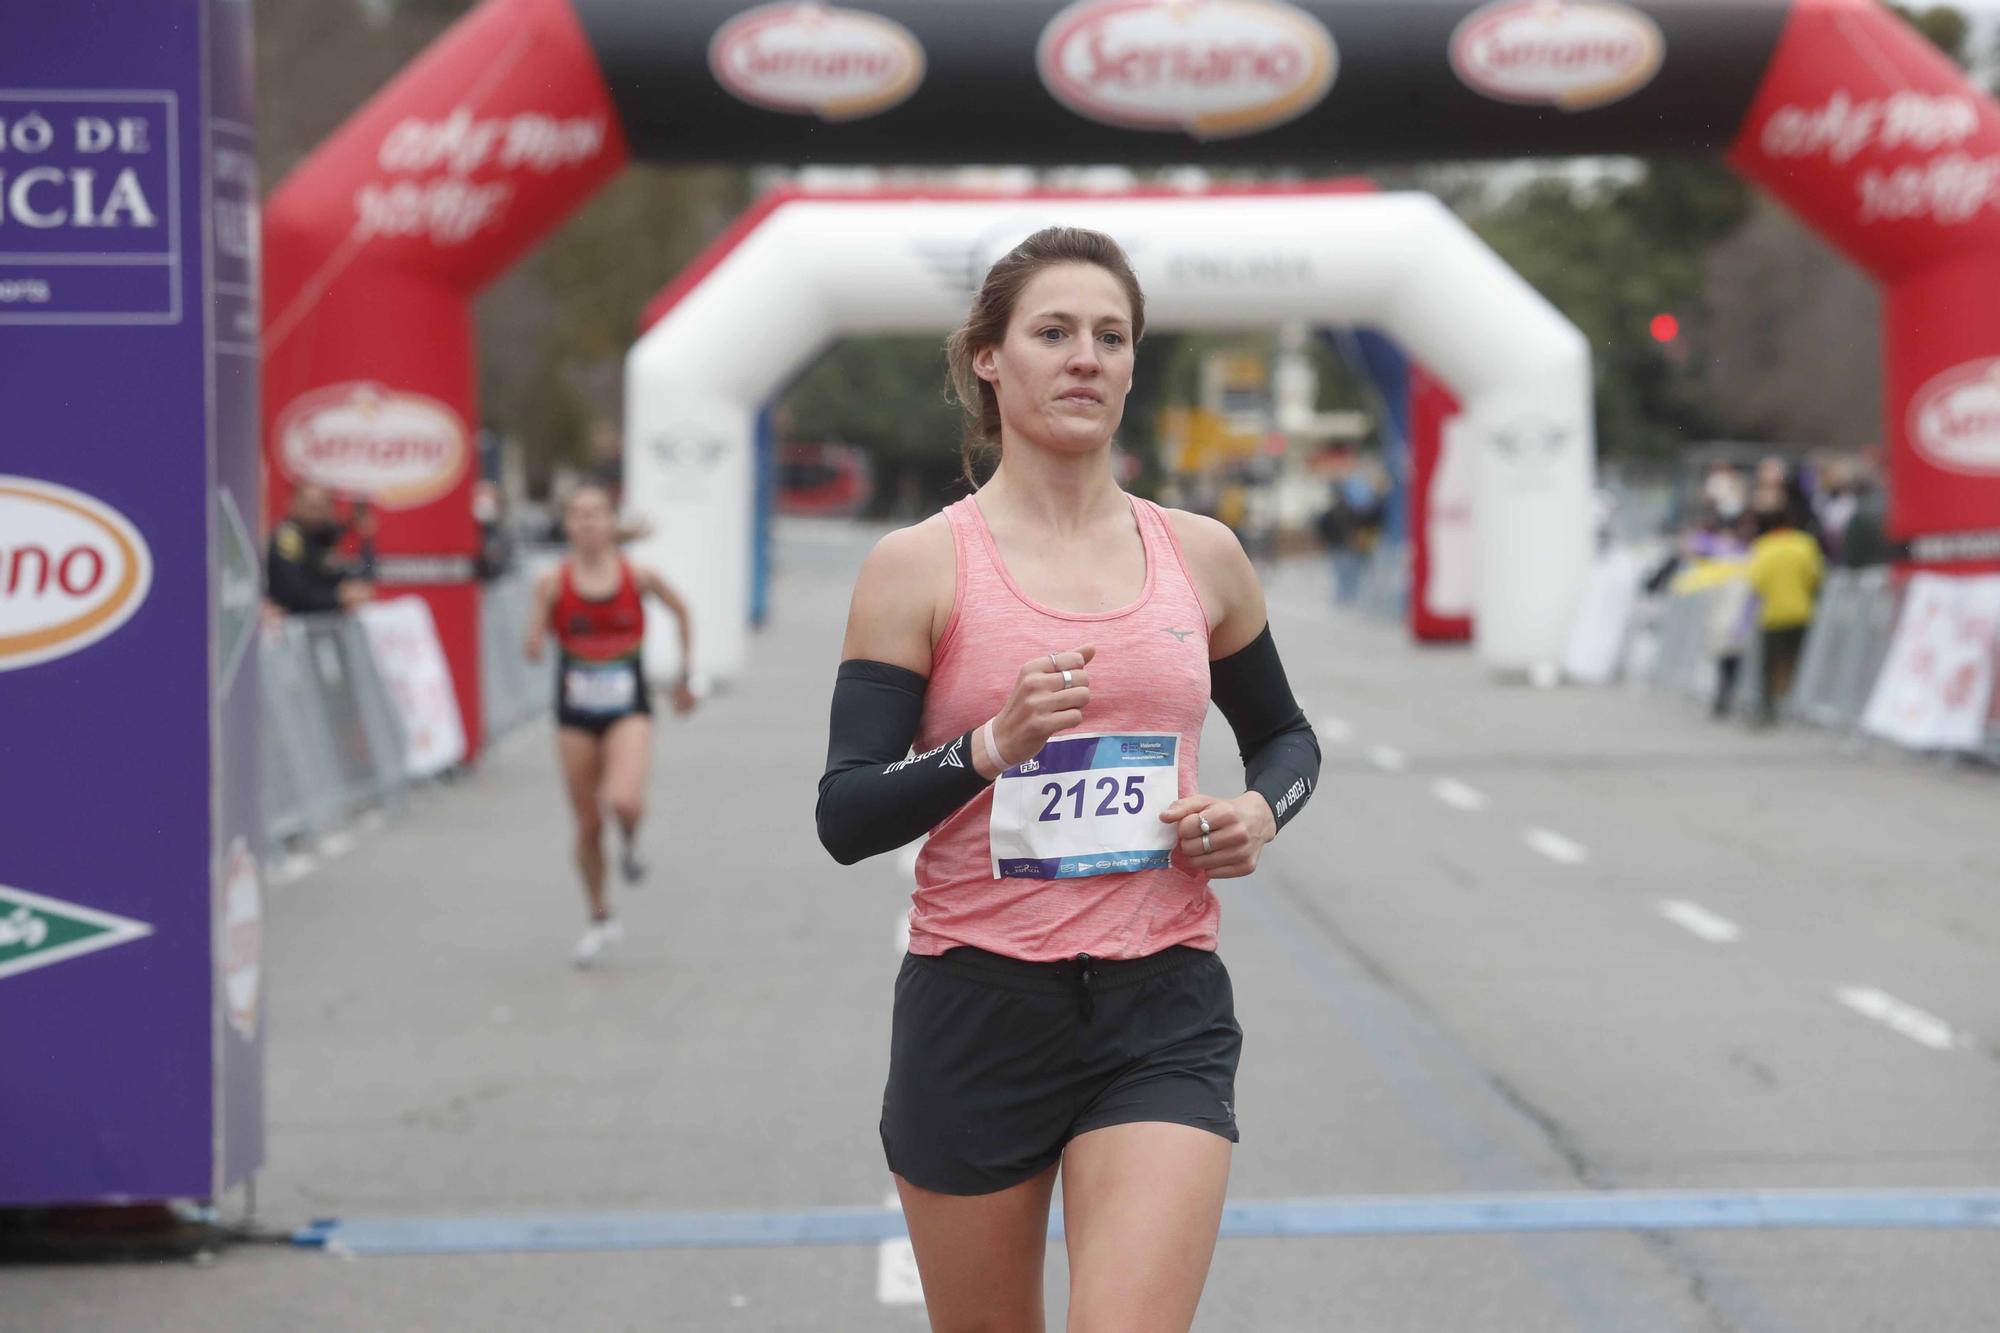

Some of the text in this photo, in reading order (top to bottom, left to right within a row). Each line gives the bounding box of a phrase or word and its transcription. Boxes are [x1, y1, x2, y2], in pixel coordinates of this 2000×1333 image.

[75, 115, 150, 154] DE
[0, 165, 157, 229] CIA
[0, 544, 105, 599] no
[1038, 775, 1146, 822] 2125
